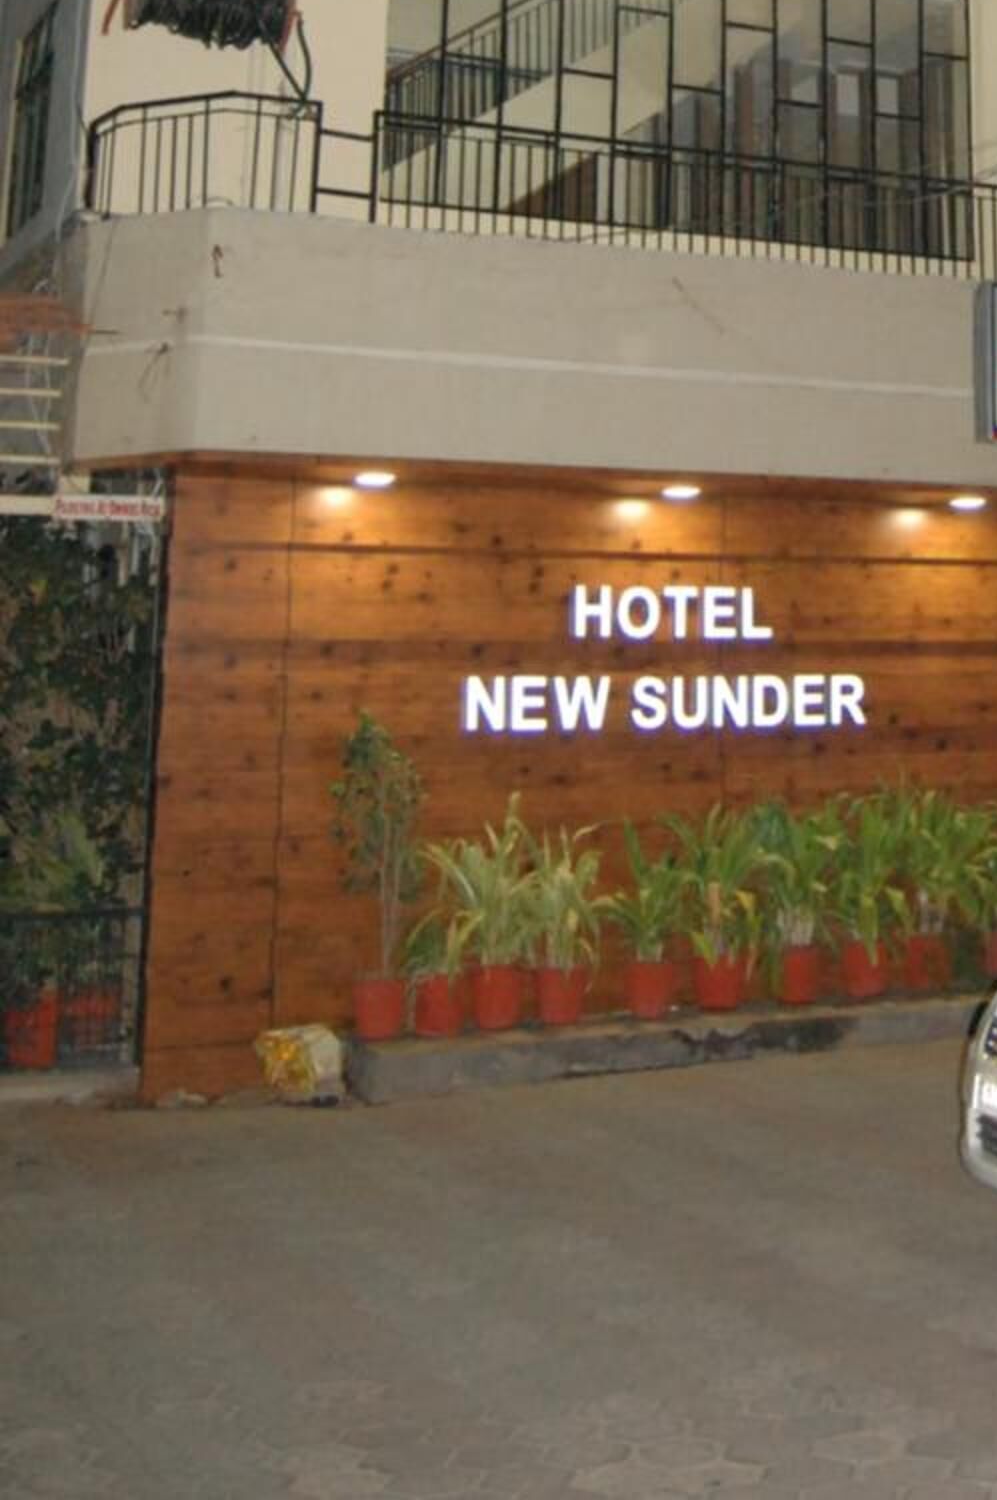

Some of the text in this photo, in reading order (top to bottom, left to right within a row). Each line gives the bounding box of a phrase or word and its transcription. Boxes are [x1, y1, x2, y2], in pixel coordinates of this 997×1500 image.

[571, 584, 774, 640] HOTEL
[463, 674, 867, 732] NEW SUNDER
